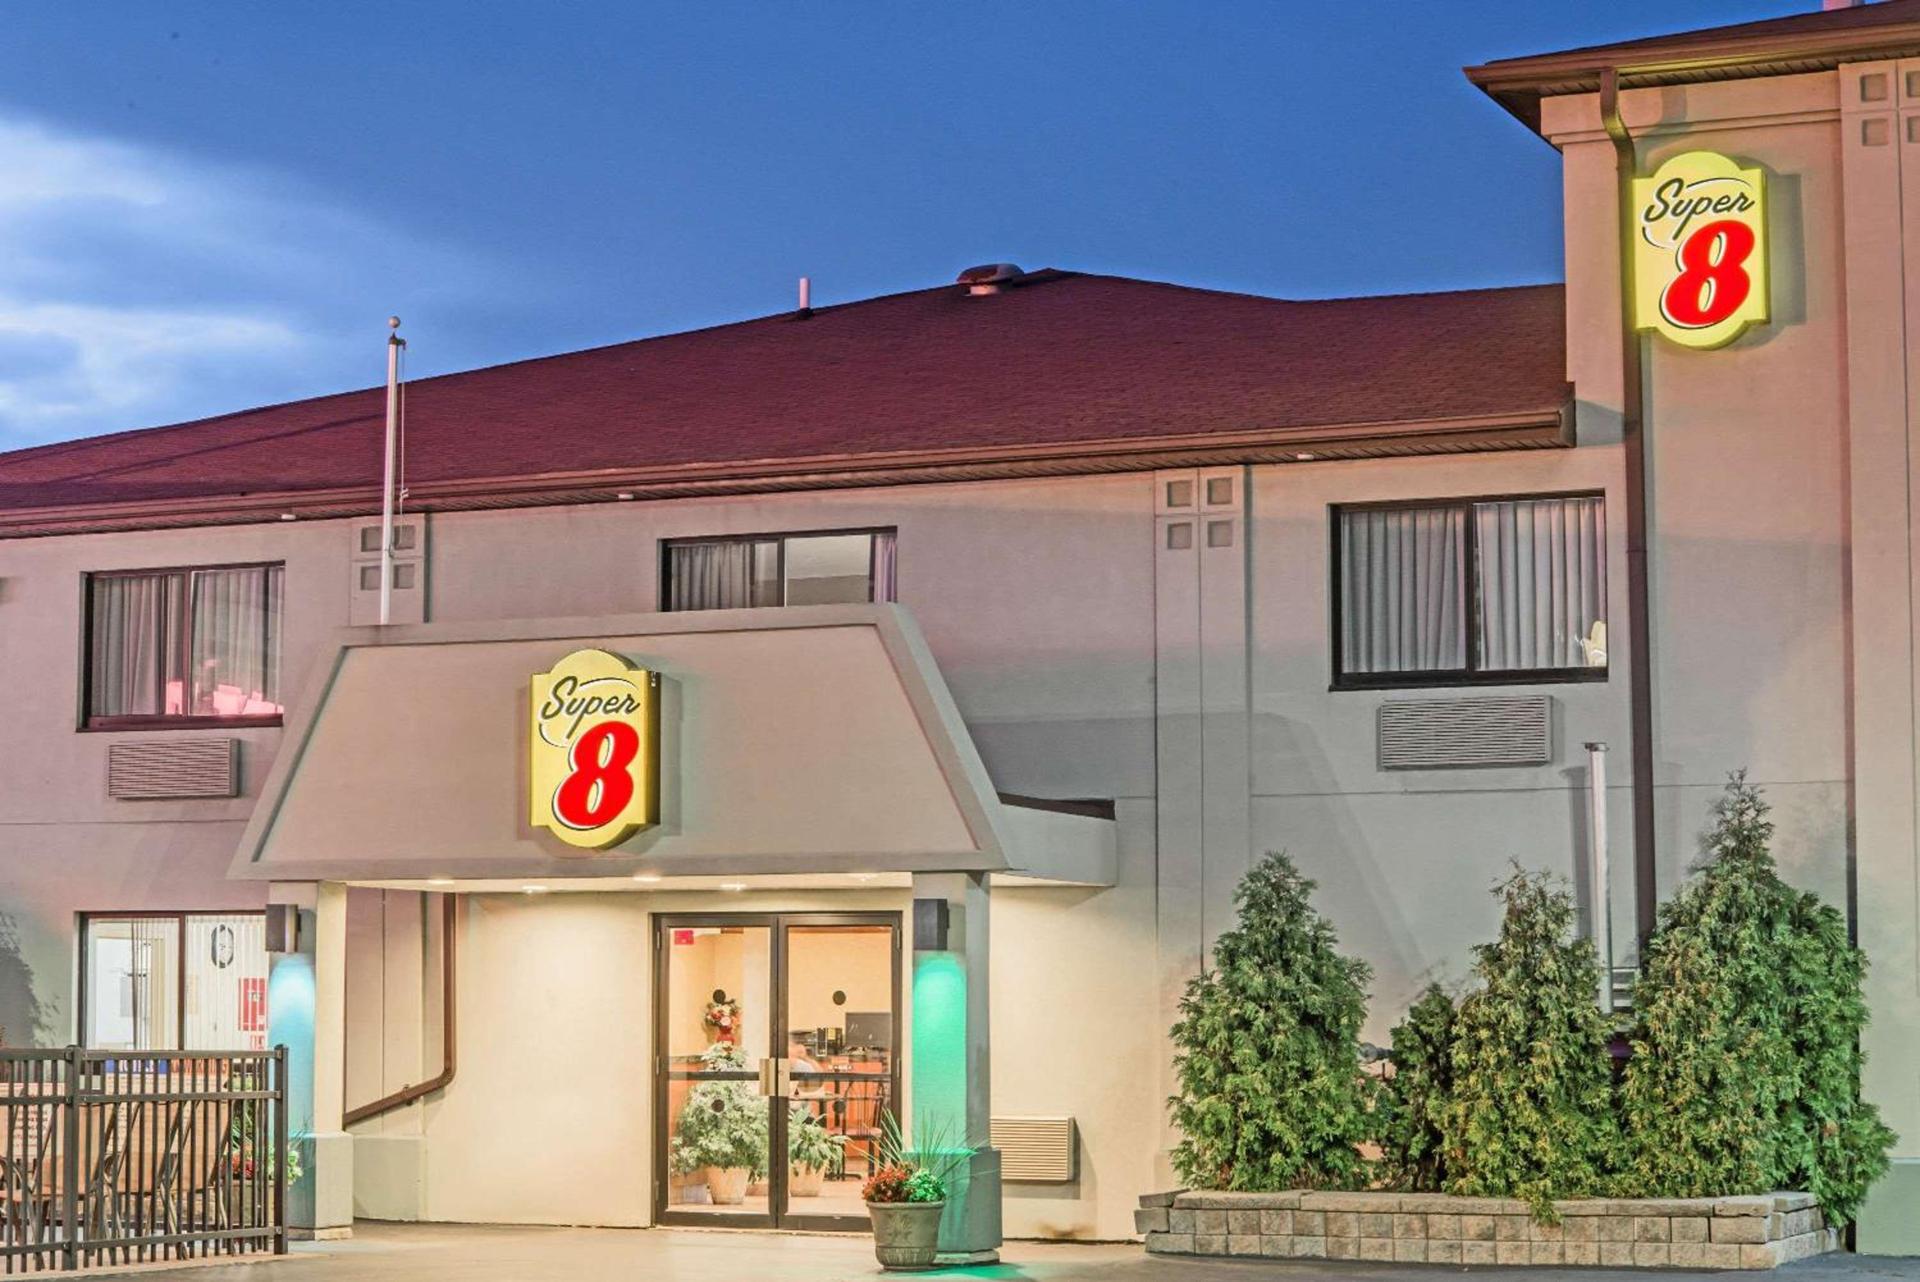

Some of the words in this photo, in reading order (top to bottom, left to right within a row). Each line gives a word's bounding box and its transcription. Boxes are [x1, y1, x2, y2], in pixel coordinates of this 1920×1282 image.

[1643, 177, 1755, 240] Super
[1662, 219, 1755, 327] 8
[541, 676, 641, 739] Super
[554, 720, 640, 829] 8
